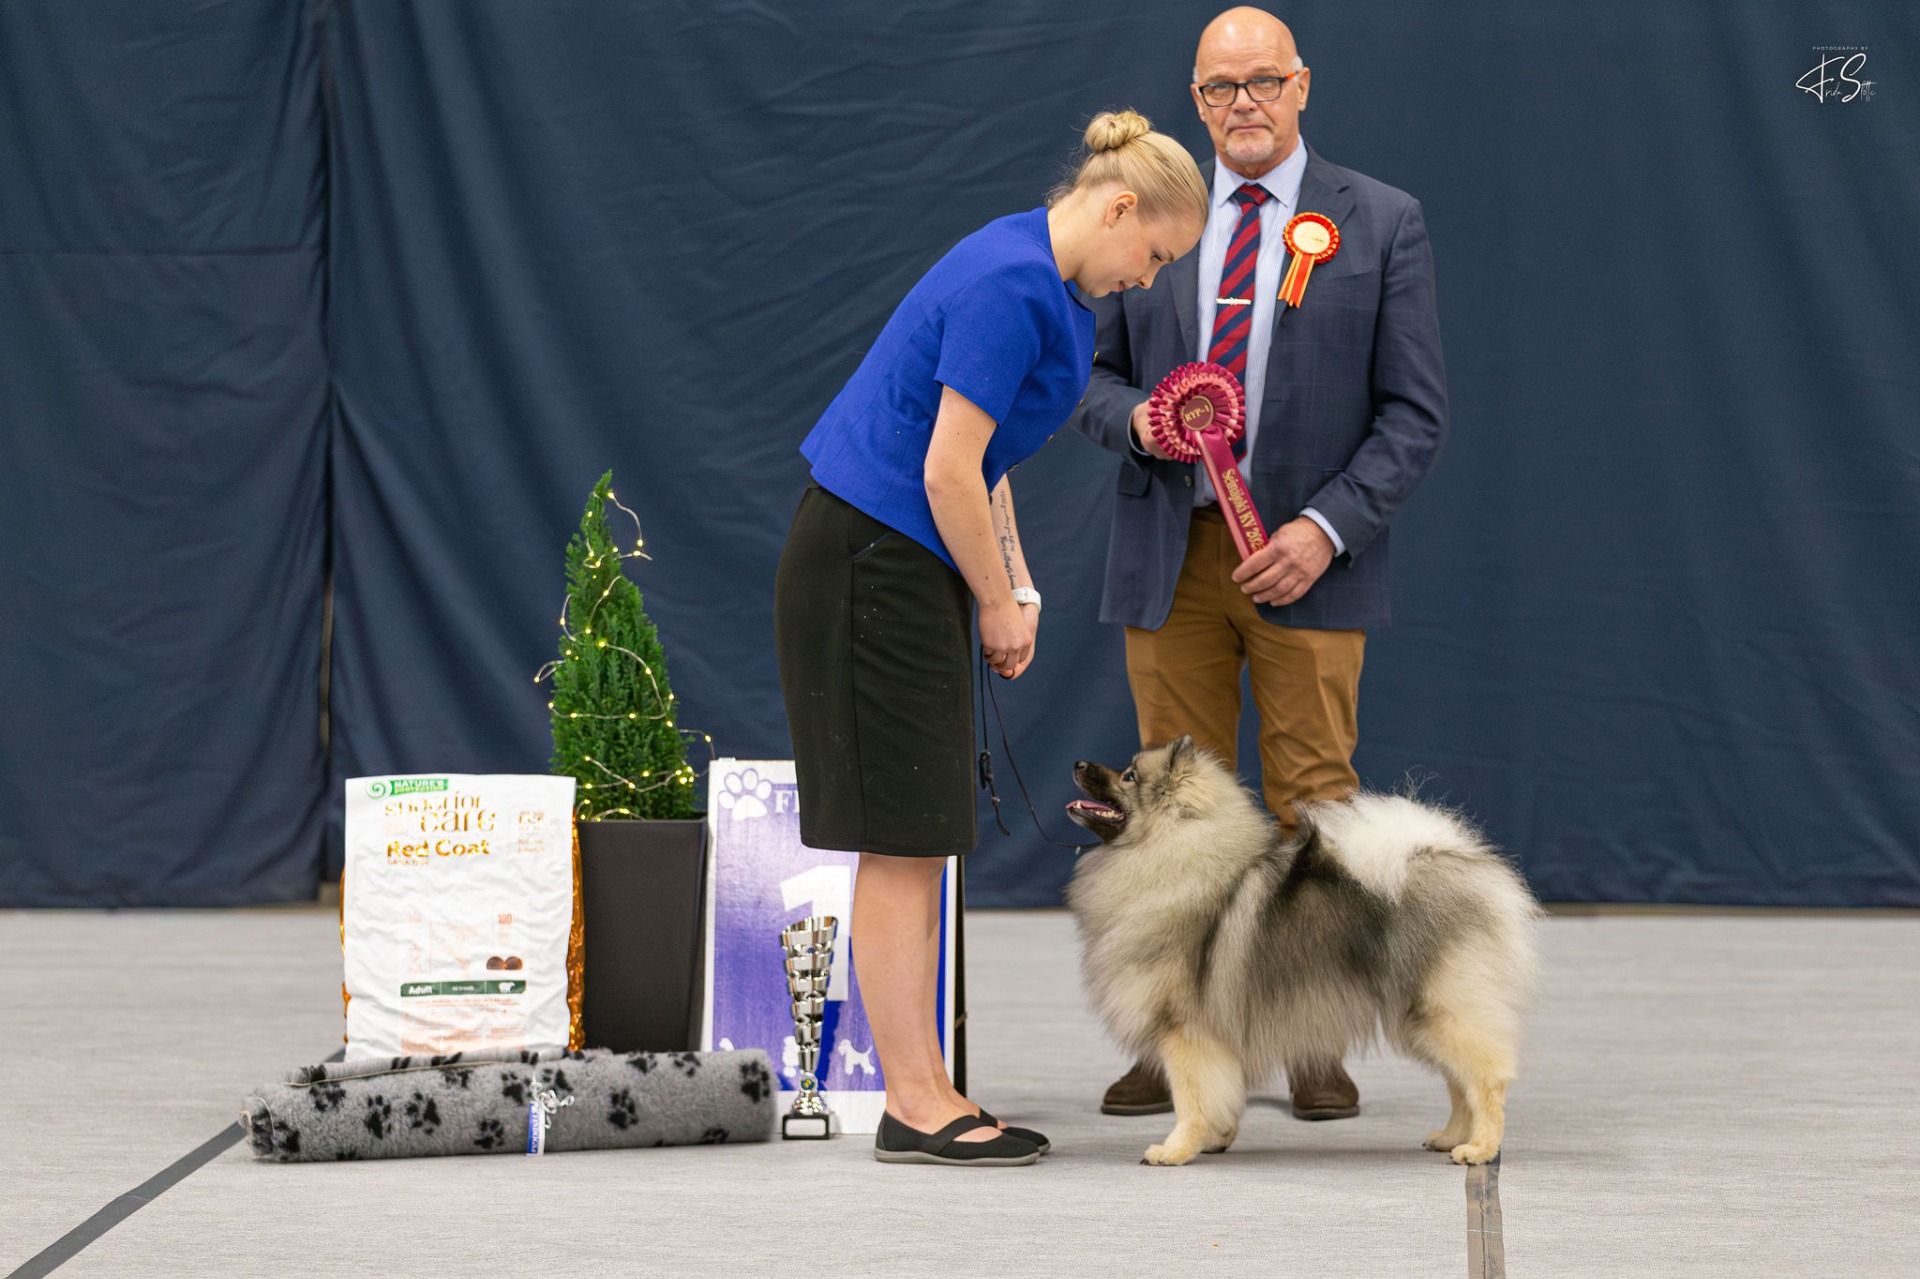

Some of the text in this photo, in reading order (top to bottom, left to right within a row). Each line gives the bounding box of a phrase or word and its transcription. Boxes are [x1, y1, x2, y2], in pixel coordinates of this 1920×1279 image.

[1184, 404, 1210, 422] RYP-1
[1221, 468, 1250, 513] Seinäjoki
[1239, 510, 1258, 533] KV
[420, 809, 496, 833] care
[386, 839, 489, 858] Red Coat
[780, 865, 850, 1001] 1
[408, 985, 433, 995] Adult
